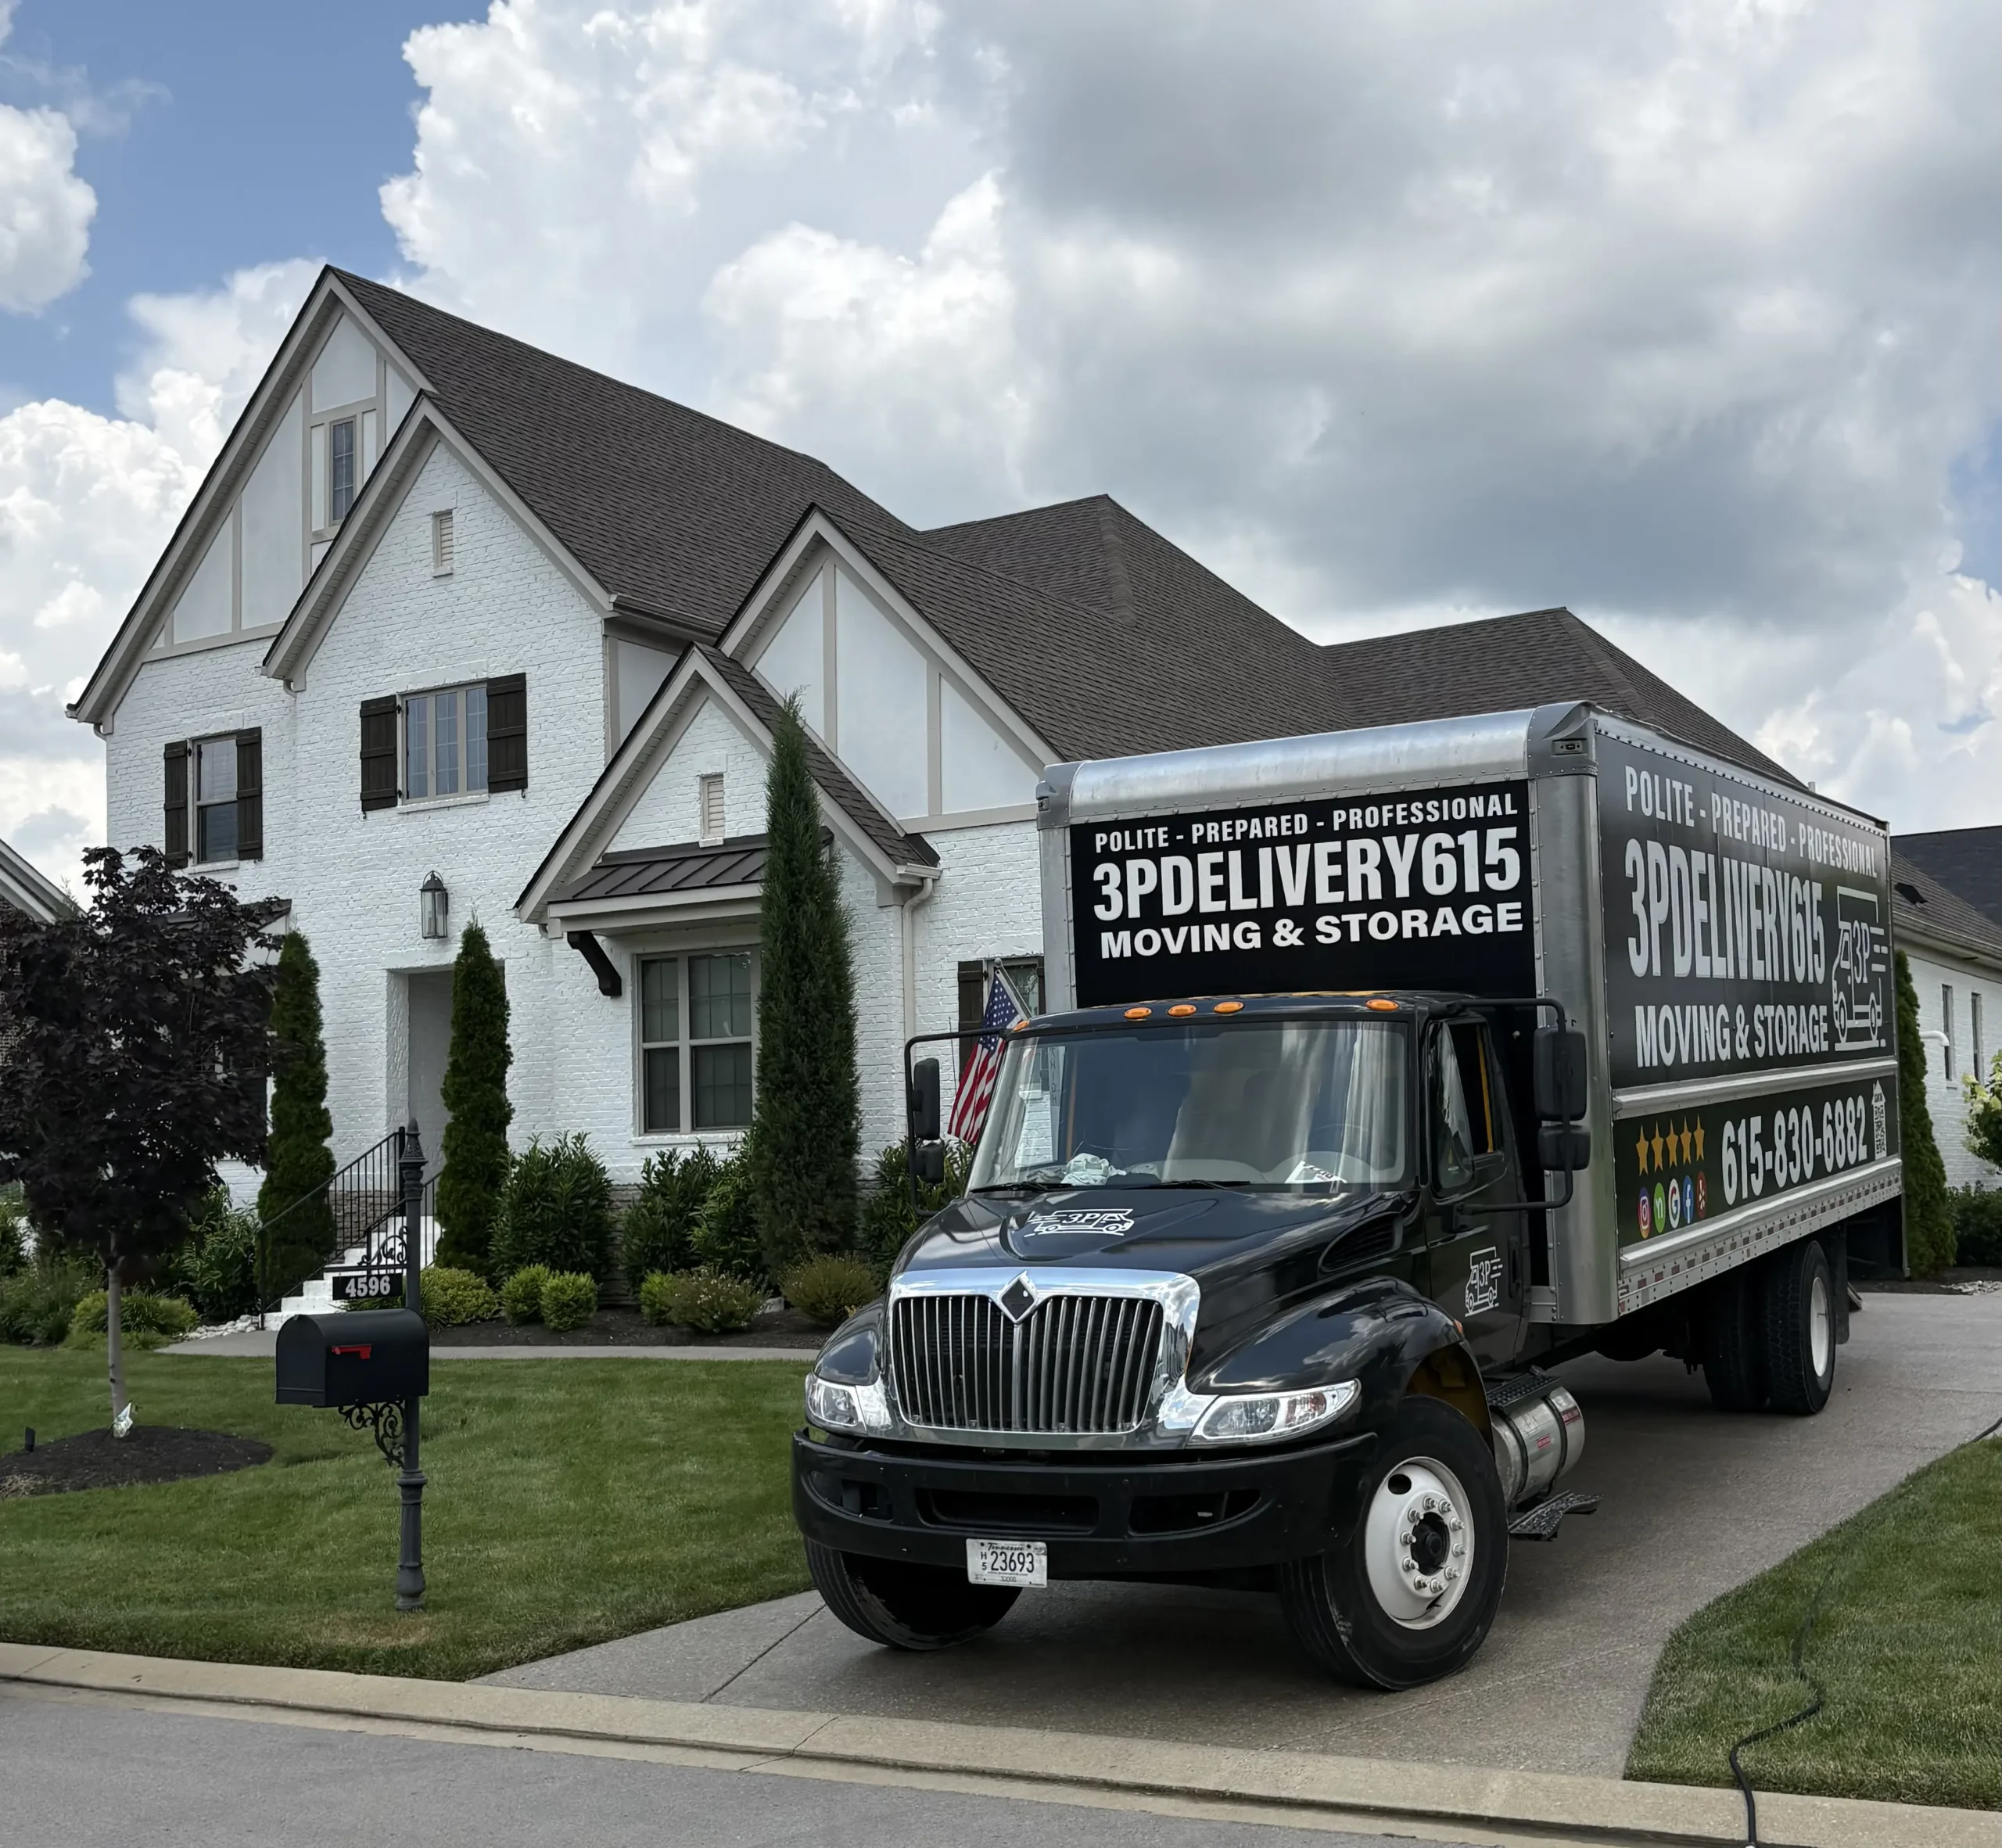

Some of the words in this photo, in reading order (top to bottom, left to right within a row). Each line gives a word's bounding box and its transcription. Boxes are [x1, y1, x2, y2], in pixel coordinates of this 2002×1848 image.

[1095, 827, 1169, 853] POLITE
[1191, 813, 1308, 845] PREPARED
[1333, 793, 1518, 831] PROFESSIONAL
[1625, 766, 1695, 827] POLITE
[1712, 792, 1787, 852] PREPARED
[1799, 822, 1878, 878] PROFESSIONAL
[1093, 826, 1520, 921] 3PDELIVERY615
[1101, 920, 1261, 959] MOVING
[1272, 918, 1305, 947] &
[1315, 902, 1523, 944] STORAGE
[1625, 838, 1825, 984] 3PDELIVERY615
[1853, 920, 1870, 984] 3P
[1634, 1004, 1731, 1068] MOVING
[1735, 1004, 1751, 1059] &
[1753, 1004, 1829, 1057] STORAGE
[1721, 1095, 1867, 1205] 615-830-6882
[1061, 1213, 1101, 1224] 3P
[345, 1276, 390, 1297] 4596
[1479, 1260, 1491, 1287] 3P
[990, 1551, 1034, 1573] 23693
